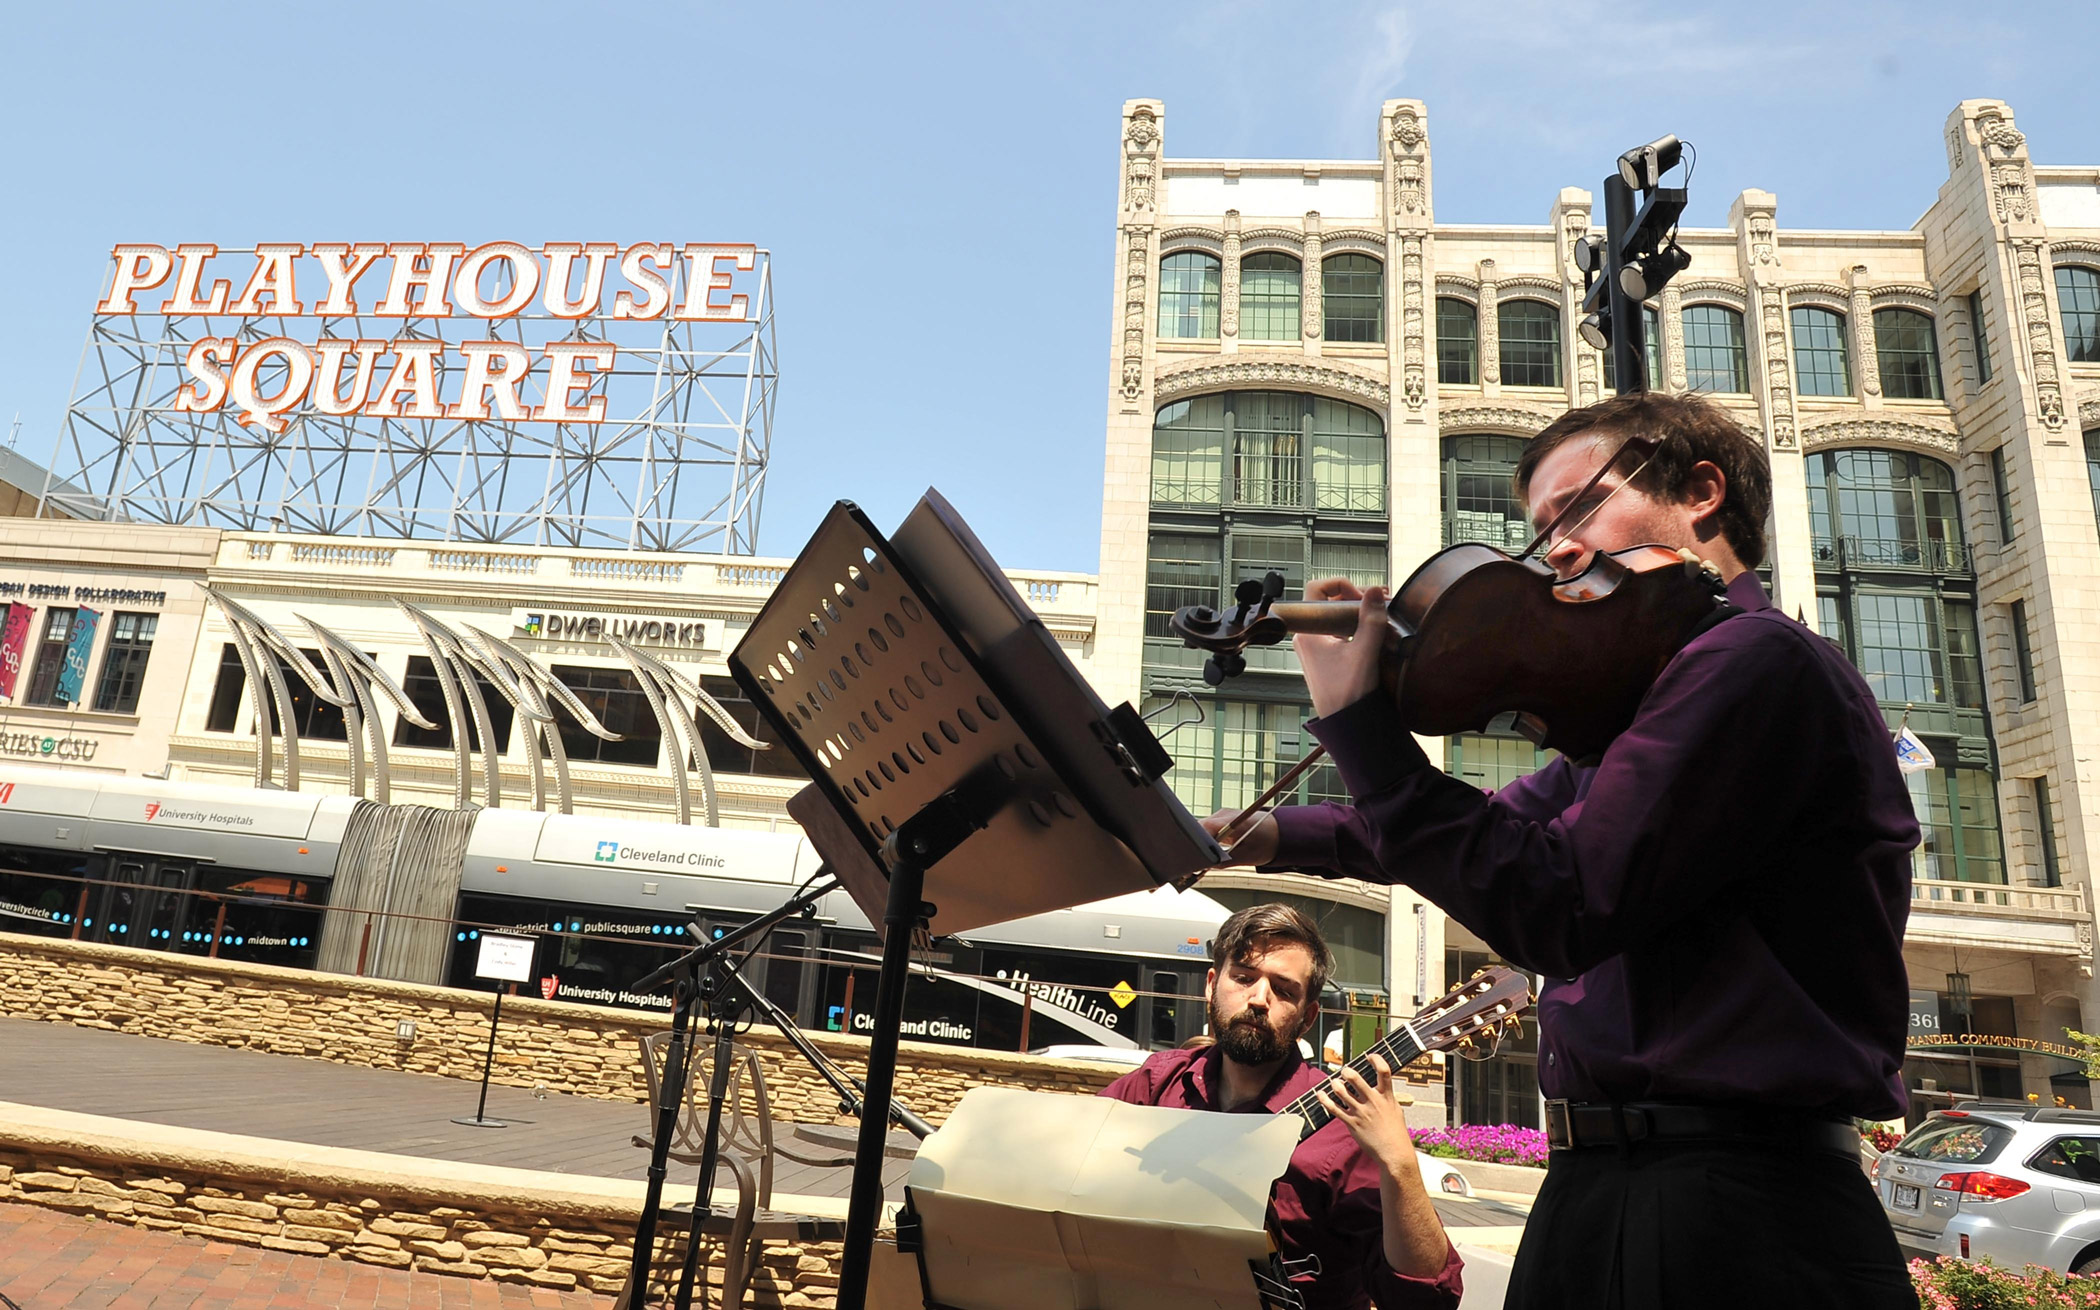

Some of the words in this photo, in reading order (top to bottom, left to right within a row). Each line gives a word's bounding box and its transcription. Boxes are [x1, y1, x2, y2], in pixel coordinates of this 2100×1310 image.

[97, 241, 756, 322] PLAYHOUSE
[175, 336, 616, 433] SQUARE
[0, 582, 25, 593] BAN
[28, 583, 70, 597] DESIGN
[75, 586, 167, 602] COLLABORATIVE
[58, 738, 98, 759] CSU
[159, 808, 206, 823] University
[209, 813, 254, 826] Hospitals
[620, 847, 685, 864] Cleveland
[688, 853, 725, 868] Clinic
[0, 901, 50, 918] versitycircle
[584, 921, 651, 935] publicsquare
[247, 935, 287, 946] midtown
[1177, 944, 1204, 955] 2908
[558, 985, 617, 1004] University
[619, 991, 673, 1008] Hospitals
[1010, 969, 1119, 1029] HealthLine
[854, 1013, 927, 1035] Cleand
[929, 1021, 972, 1040] Clinic
[1906, 1033, 1958, 1047] MANDEL
[1960, 1034, 2039, 1051] COMMUNITY
